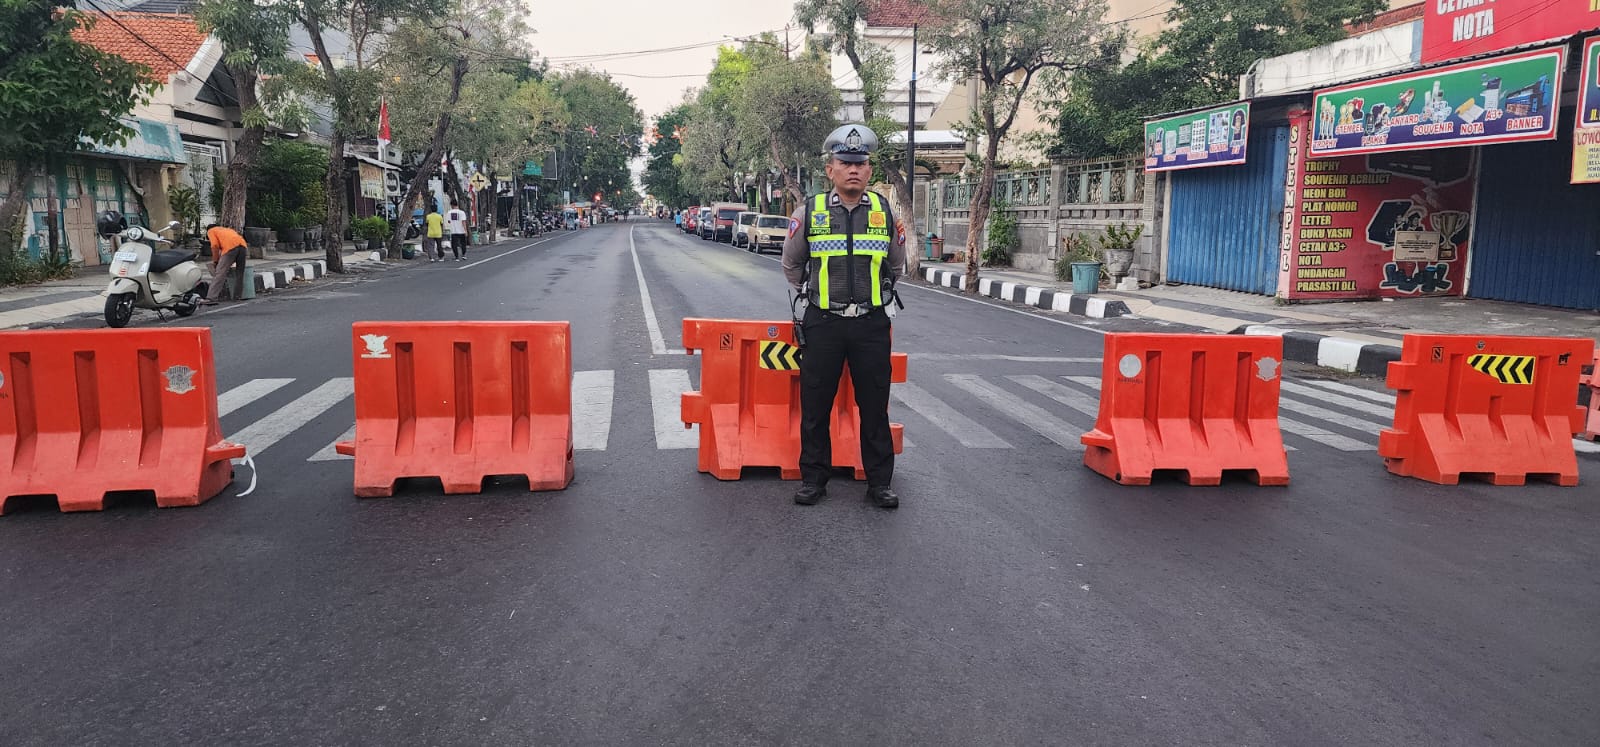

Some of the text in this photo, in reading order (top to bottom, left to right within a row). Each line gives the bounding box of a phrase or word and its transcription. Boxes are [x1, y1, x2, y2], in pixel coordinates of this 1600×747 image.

[1453, 9, 1494, 42] NOTA
[1386, 115, 1419, 126] LANYARD
[1486, 109, 1503, 121] A3+
[1335, 124, 1364, 134] STEMPEL
[1413, 122, 1453, 136] SOUVENIR
[1461, 123, 1484, 134] NOTA
[1507, 116, 1543, 131] BANNER
[1313, 139, 1337, 148] TROPHY
[1362, 134, 1388, 145] PLAKAT
[1305, 161, 1340, 172] TROPHY
[1304, 173, 1391, 185] SOUVENIR ACRILICT
[1283, 125, 1298, 271] STEMPEL
[1303, 188, 1346, 199] NEON BOX
[1302, 201, 1357, 212] PLAT NOMOR
[1301, 215, 1331, 226] LETTER
[1300, 228, 1353, 239] BUKU YASIN
[1299, 242, 1346, 252] CETAK A3+
[1298, 255, 1321, 265] NOTA
[1298, 268, 1346, 278] UNDANGAN
[1296, 281, 1356, 291] PRASASTI DLL
